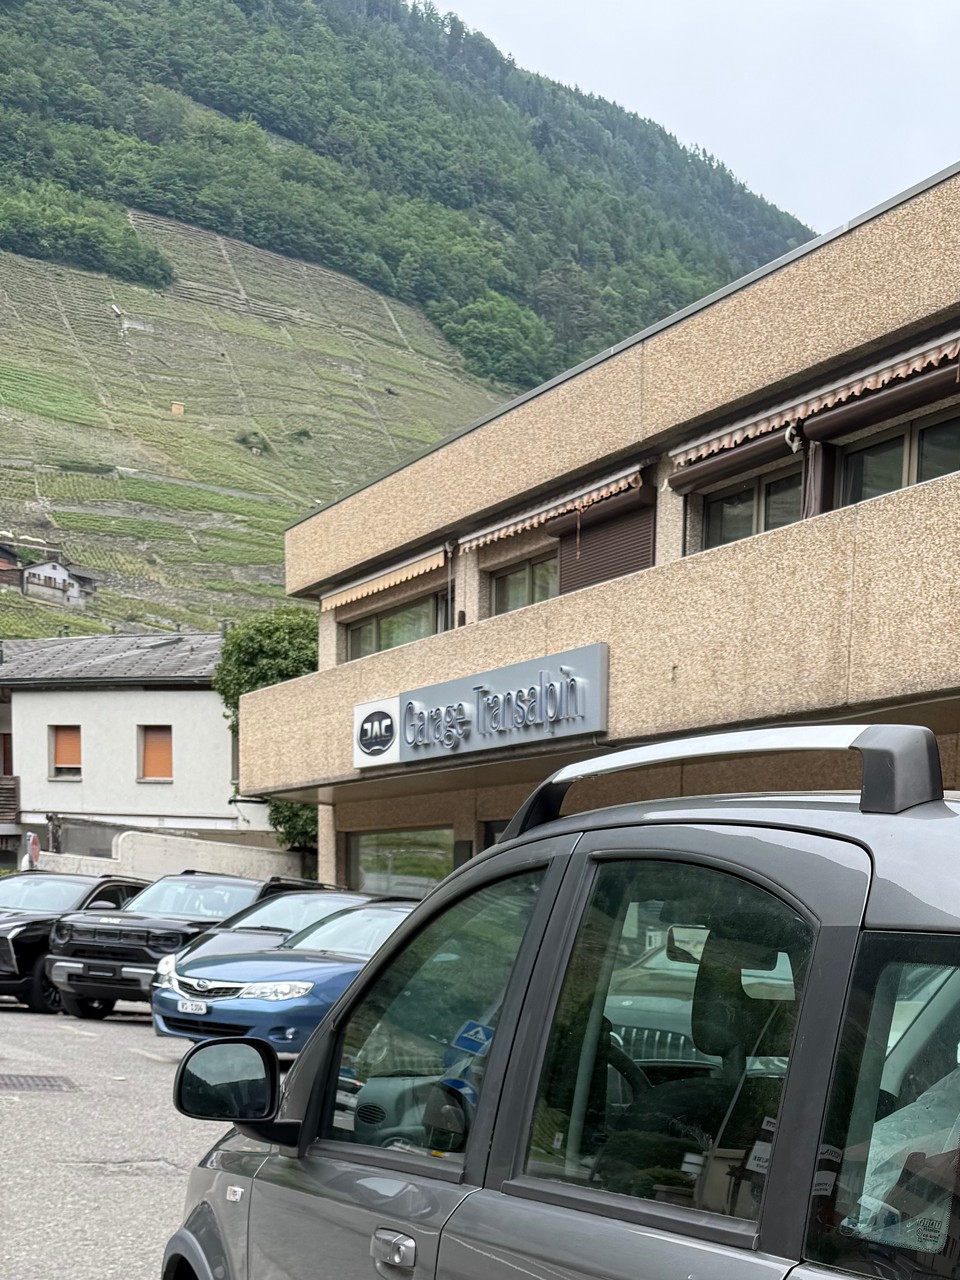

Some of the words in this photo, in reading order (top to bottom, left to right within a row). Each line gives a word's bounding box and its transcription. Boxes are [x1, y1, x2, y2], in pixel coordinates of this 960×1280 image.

[362, 718, 393, 740] JAC
[402, 700, 471, 749] Garage
[472, 665, 588, 735] Transalpin
